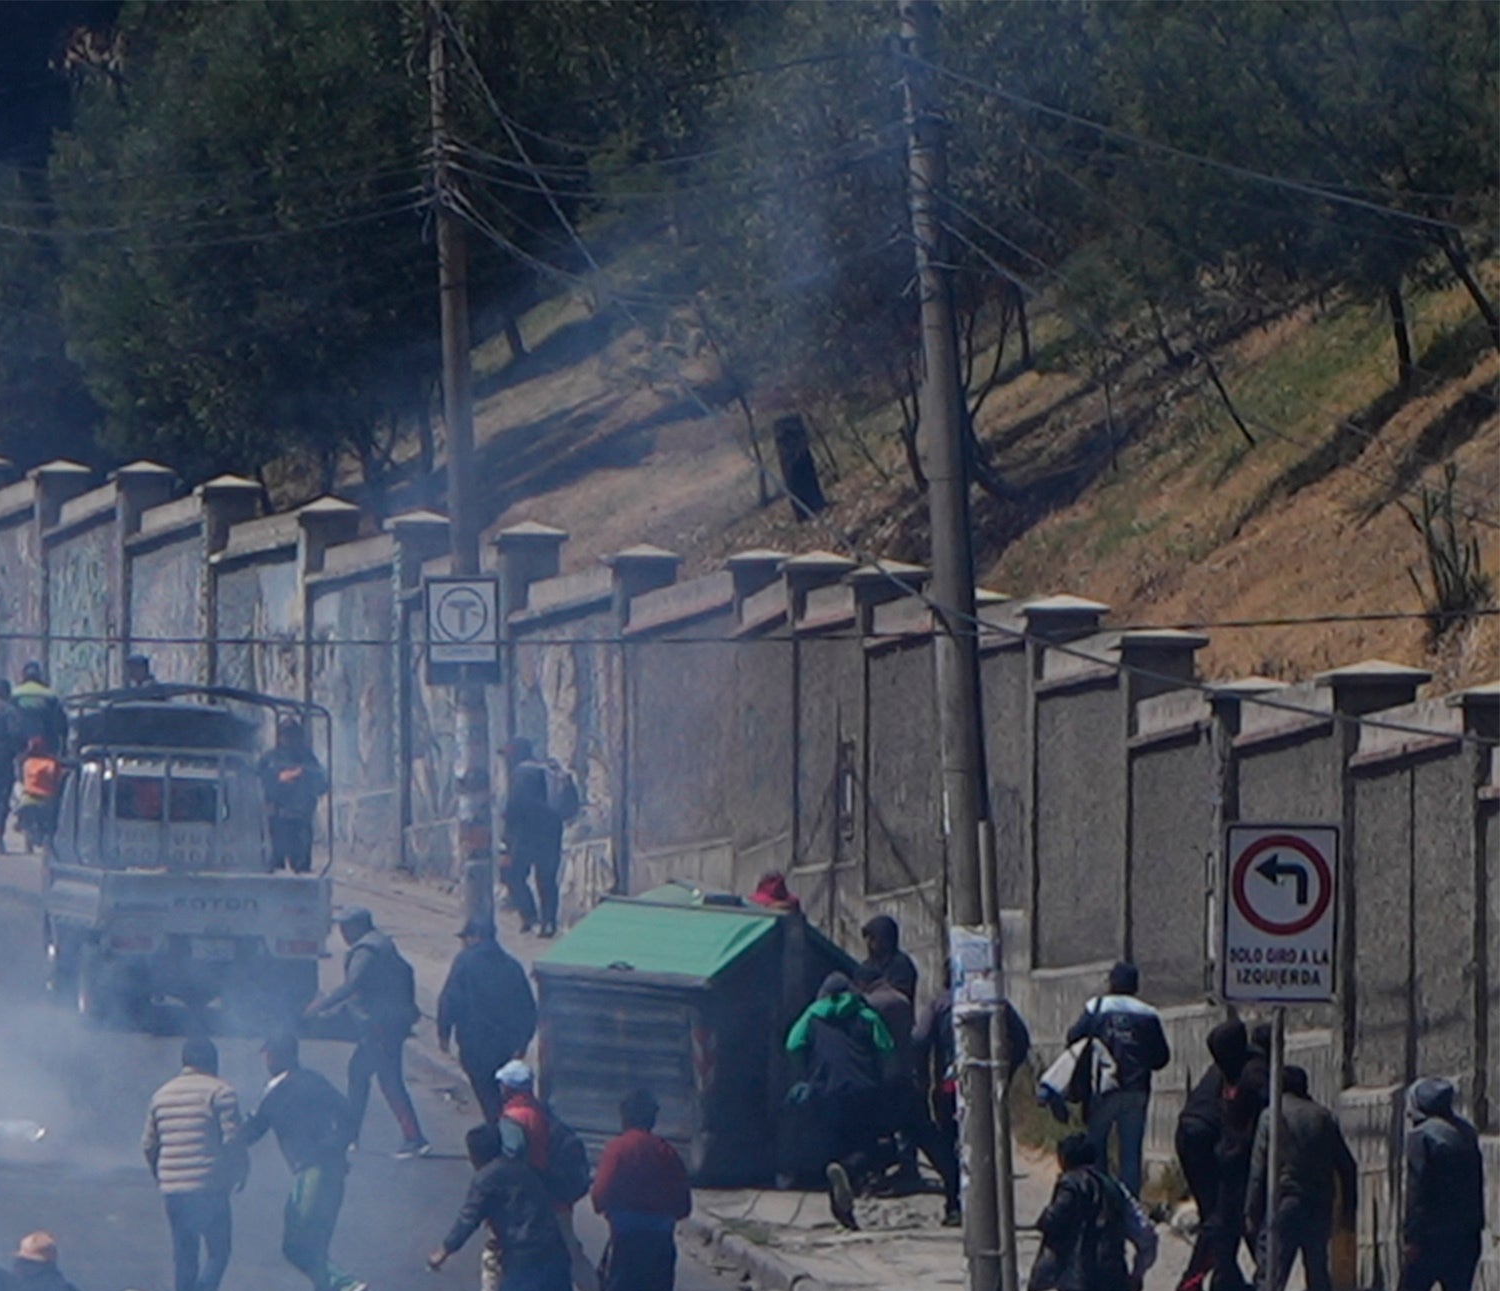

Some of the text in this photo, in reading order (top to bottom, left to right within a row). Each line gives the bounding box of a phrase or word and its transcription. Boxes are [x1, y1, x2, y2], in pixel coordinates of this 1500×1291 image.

[1230, 947, 1329, 965] SOLO GIRO A LA
[1237, 968, 1321, 985] IZQUIERDA
